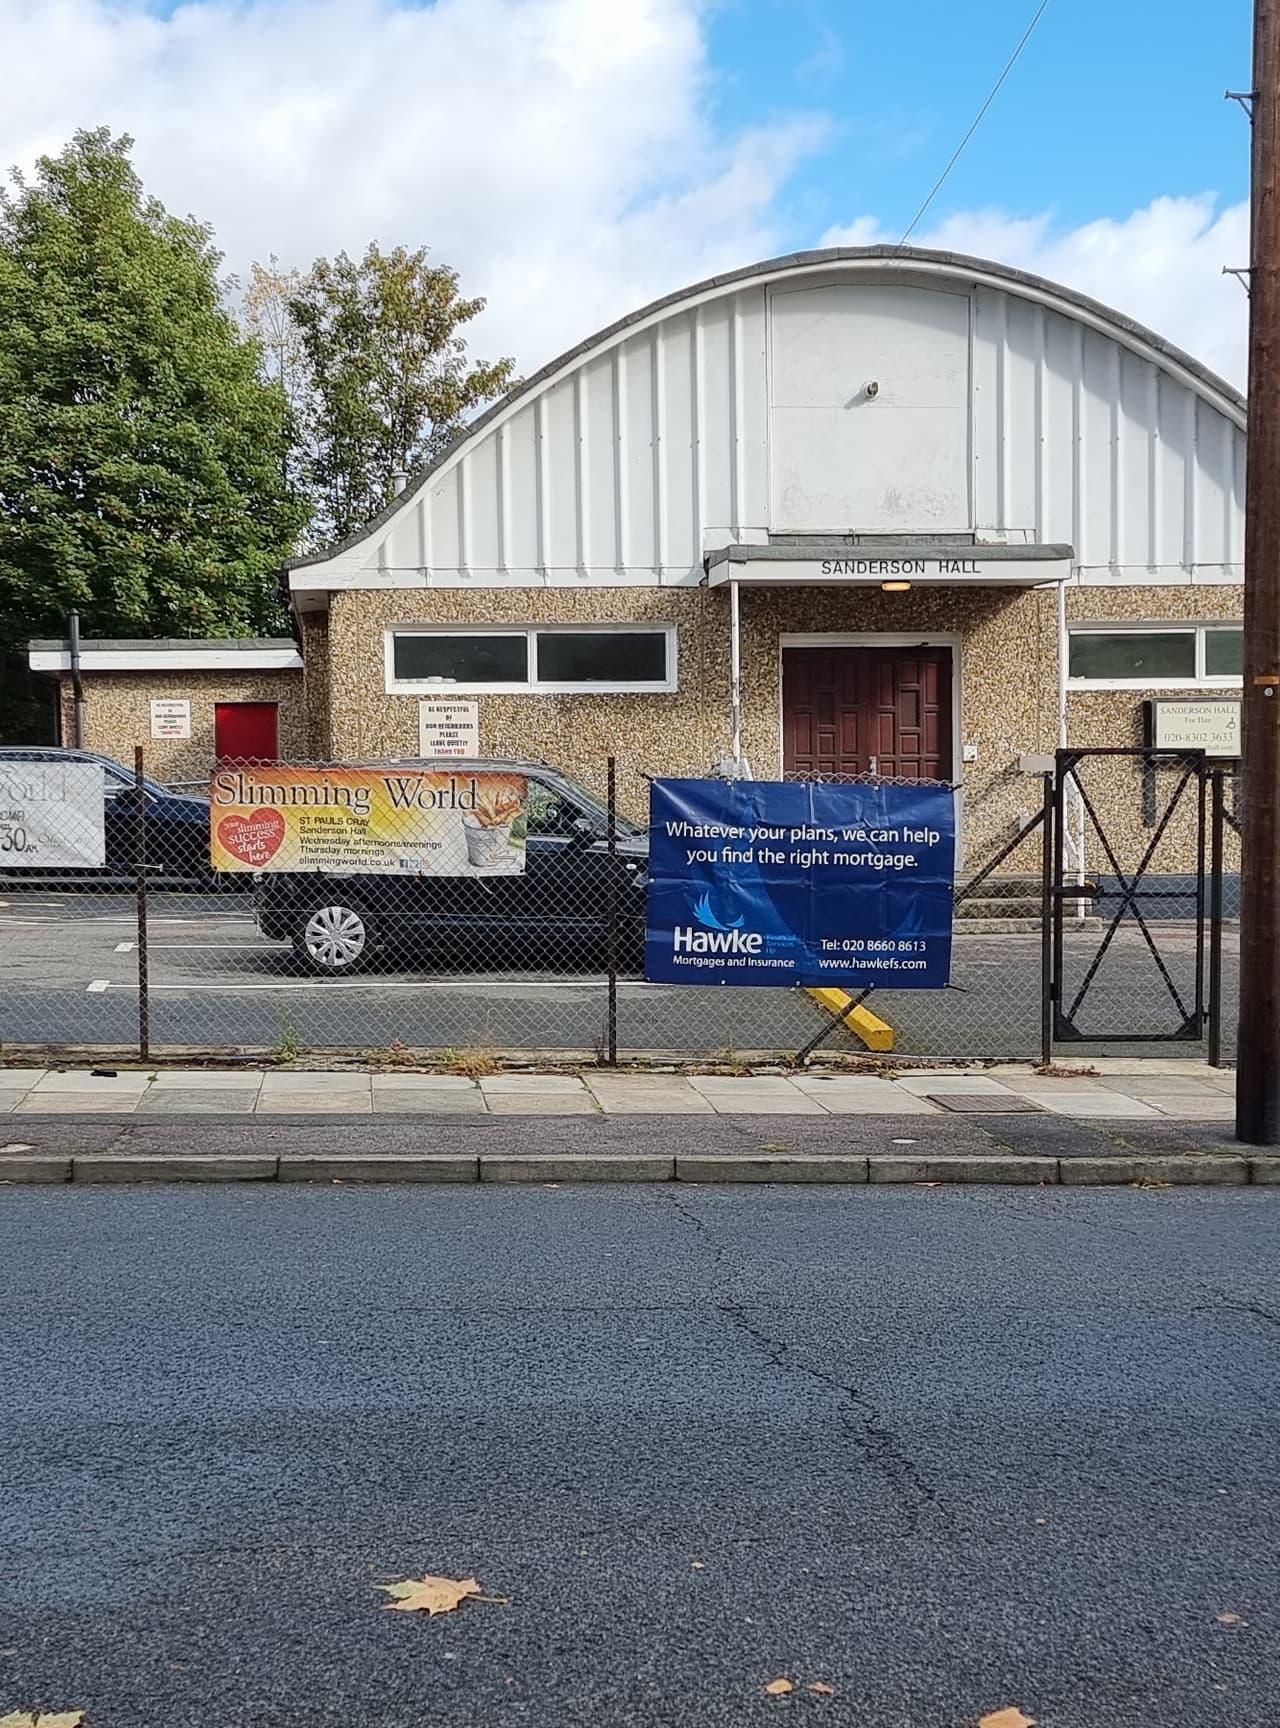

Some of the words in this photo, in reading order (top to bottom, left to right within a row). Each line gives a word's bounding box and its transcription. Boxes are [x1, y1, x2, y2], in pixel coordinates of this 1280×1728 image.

[821, 560, 925, 575] SANDERSON
[939, 560, 981, 574] HALL
[1160, 706, 1212, 714] SANDERSON
[1214, 706, 1237, 714] HALL
[216, 774, 370, 814] Slimming
[382, 777, 477, 811] World
[314, 817, 344, 825] PAULS
[300, 826, 347, 834] Sanderson
[666, 821, 744, 839] Whatever
[749, 827, 785, 845] your
[791, 825, 837, 843] plans,
[842, 829, 866, 841] we
[870, 830, 899, 842] can
[903, 827, 940, 846] help
[300, 837, 350, 846] Wednesday
[248, 850, 271, 862] here
[300, 846, 340, 855] Thursday
[687, 849, 718, 866] you
[722, 847, 753, 863] find
[758, 848, 785, 864] the
[790, 849, 829, 868] right
[834, 853, 918, 870] mortgage.
[674, 926, 763, 954] Hawke
[821, 939, 840, 951] Tel:
[843, 940, 864, 951] 020
[867, 940, 896, 952] 8660
[898, 940, 926, 953] 8613
[673, 955, 725, 968] Mortgages
[727, 957, 746, 966] and
[748, 957, 795, 968] Insurance
[819, 957, 927, 970] www.hawkefs.com
